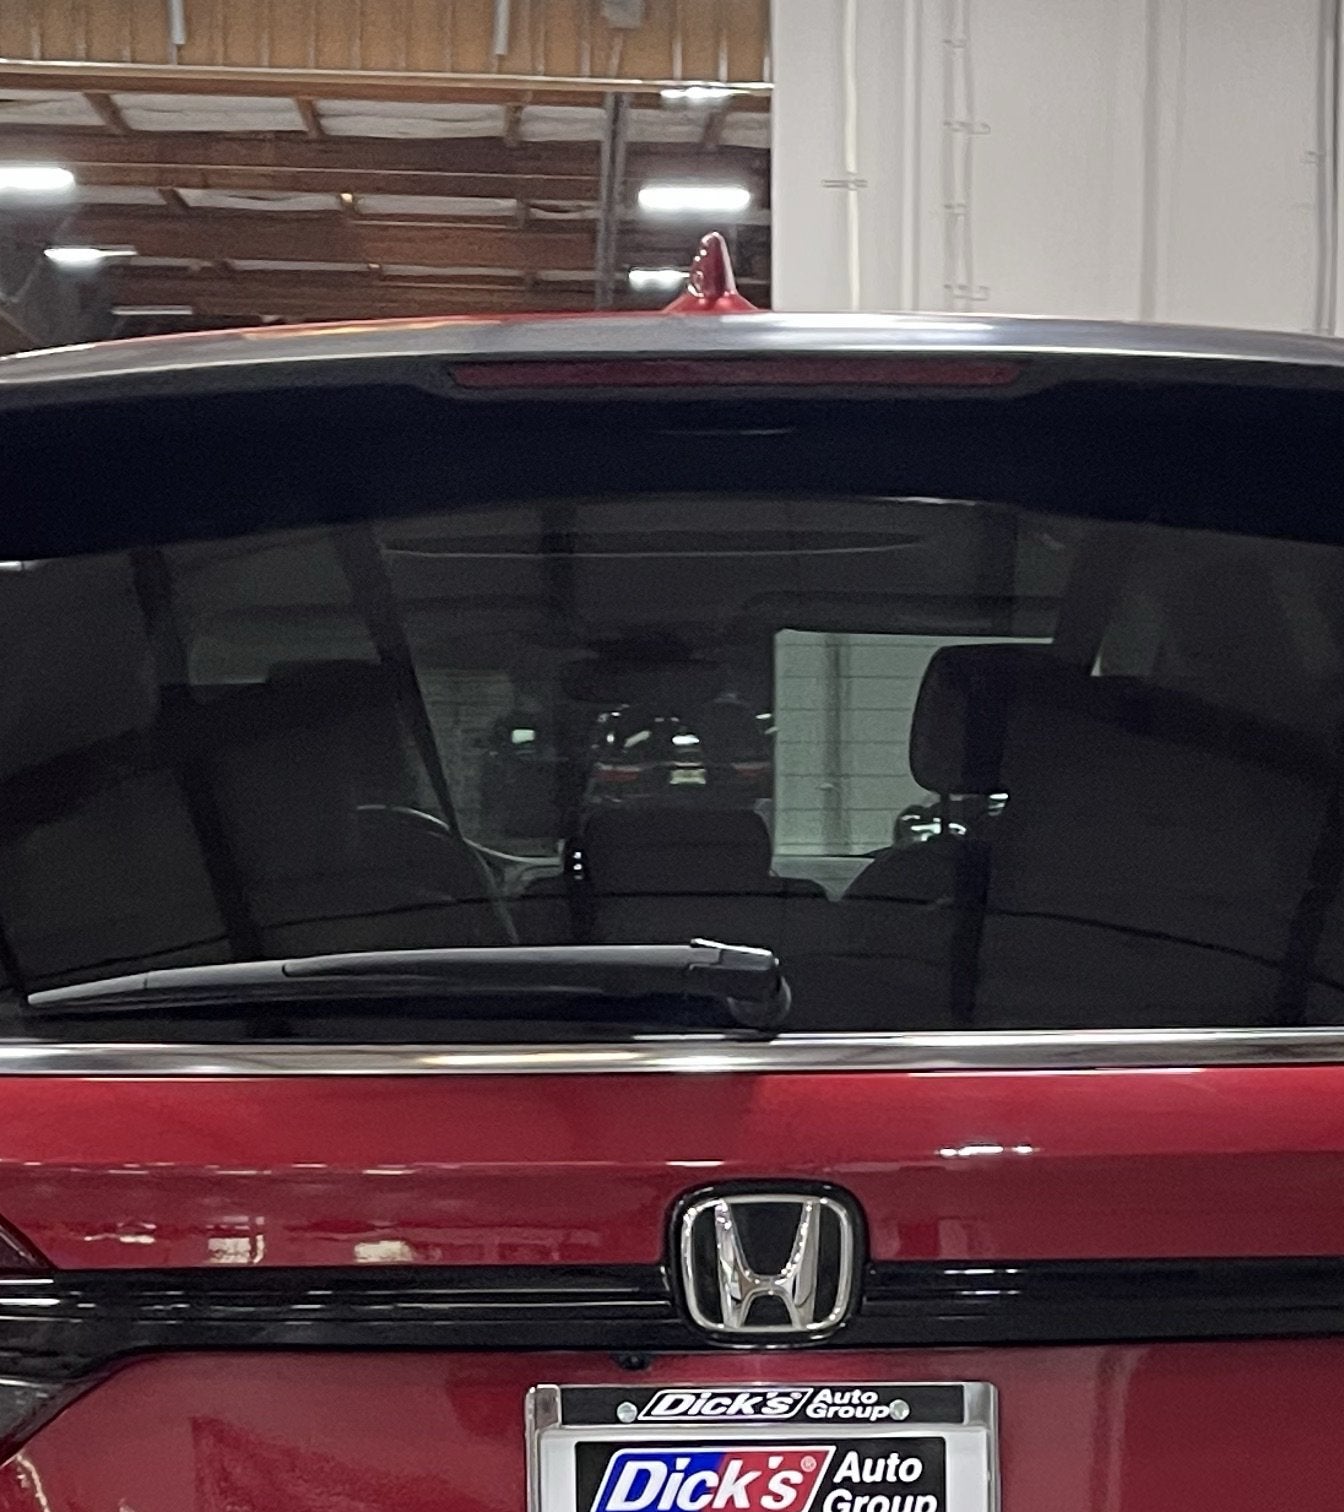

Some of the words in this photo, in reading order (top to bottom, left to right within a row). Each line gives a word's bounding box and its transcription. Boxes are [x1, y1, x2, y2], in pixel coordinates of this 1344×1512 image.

[650, 1391, 796, 1416] Dick's
[812, 1388, 879, 1405] Auto
[805, 1403, 891, 1422] Group
[832, 1450, 924, 1484] Auto
[605, 1455, 805, 1512] Dick's
